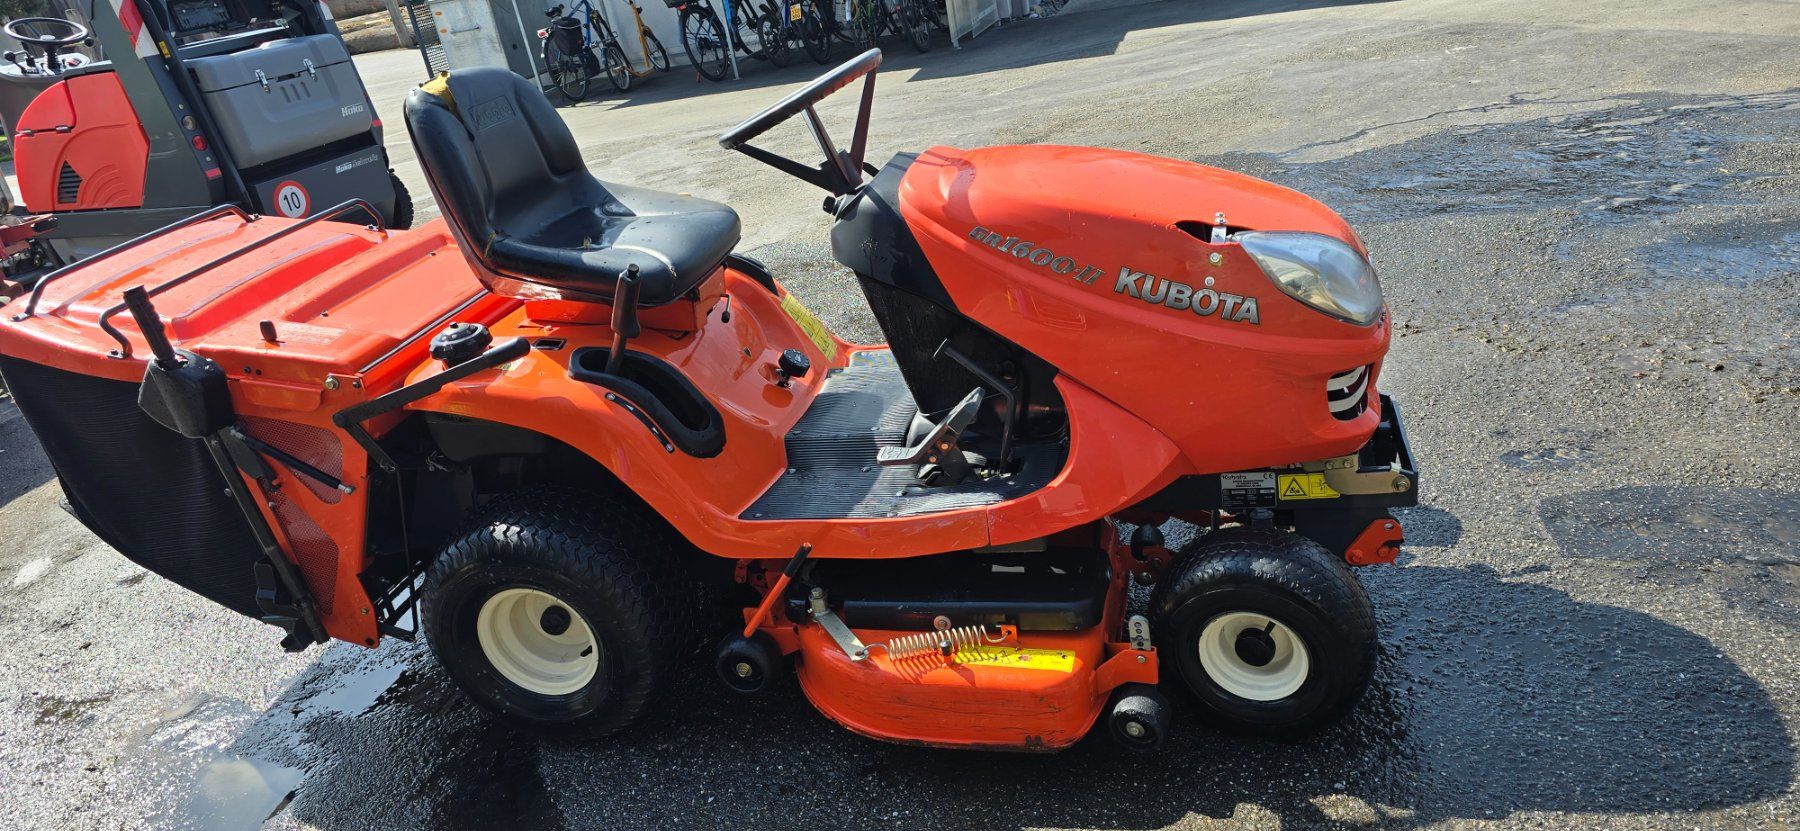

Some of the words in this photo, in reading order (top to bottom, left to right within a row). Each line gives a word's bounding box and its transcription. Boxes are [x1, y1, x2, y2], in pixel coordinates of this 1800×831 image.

[341, 103, 364, 117] Hako
[283, 192, 301, 212] 10
[1114, 266, 1260, 325] KUBOTA
